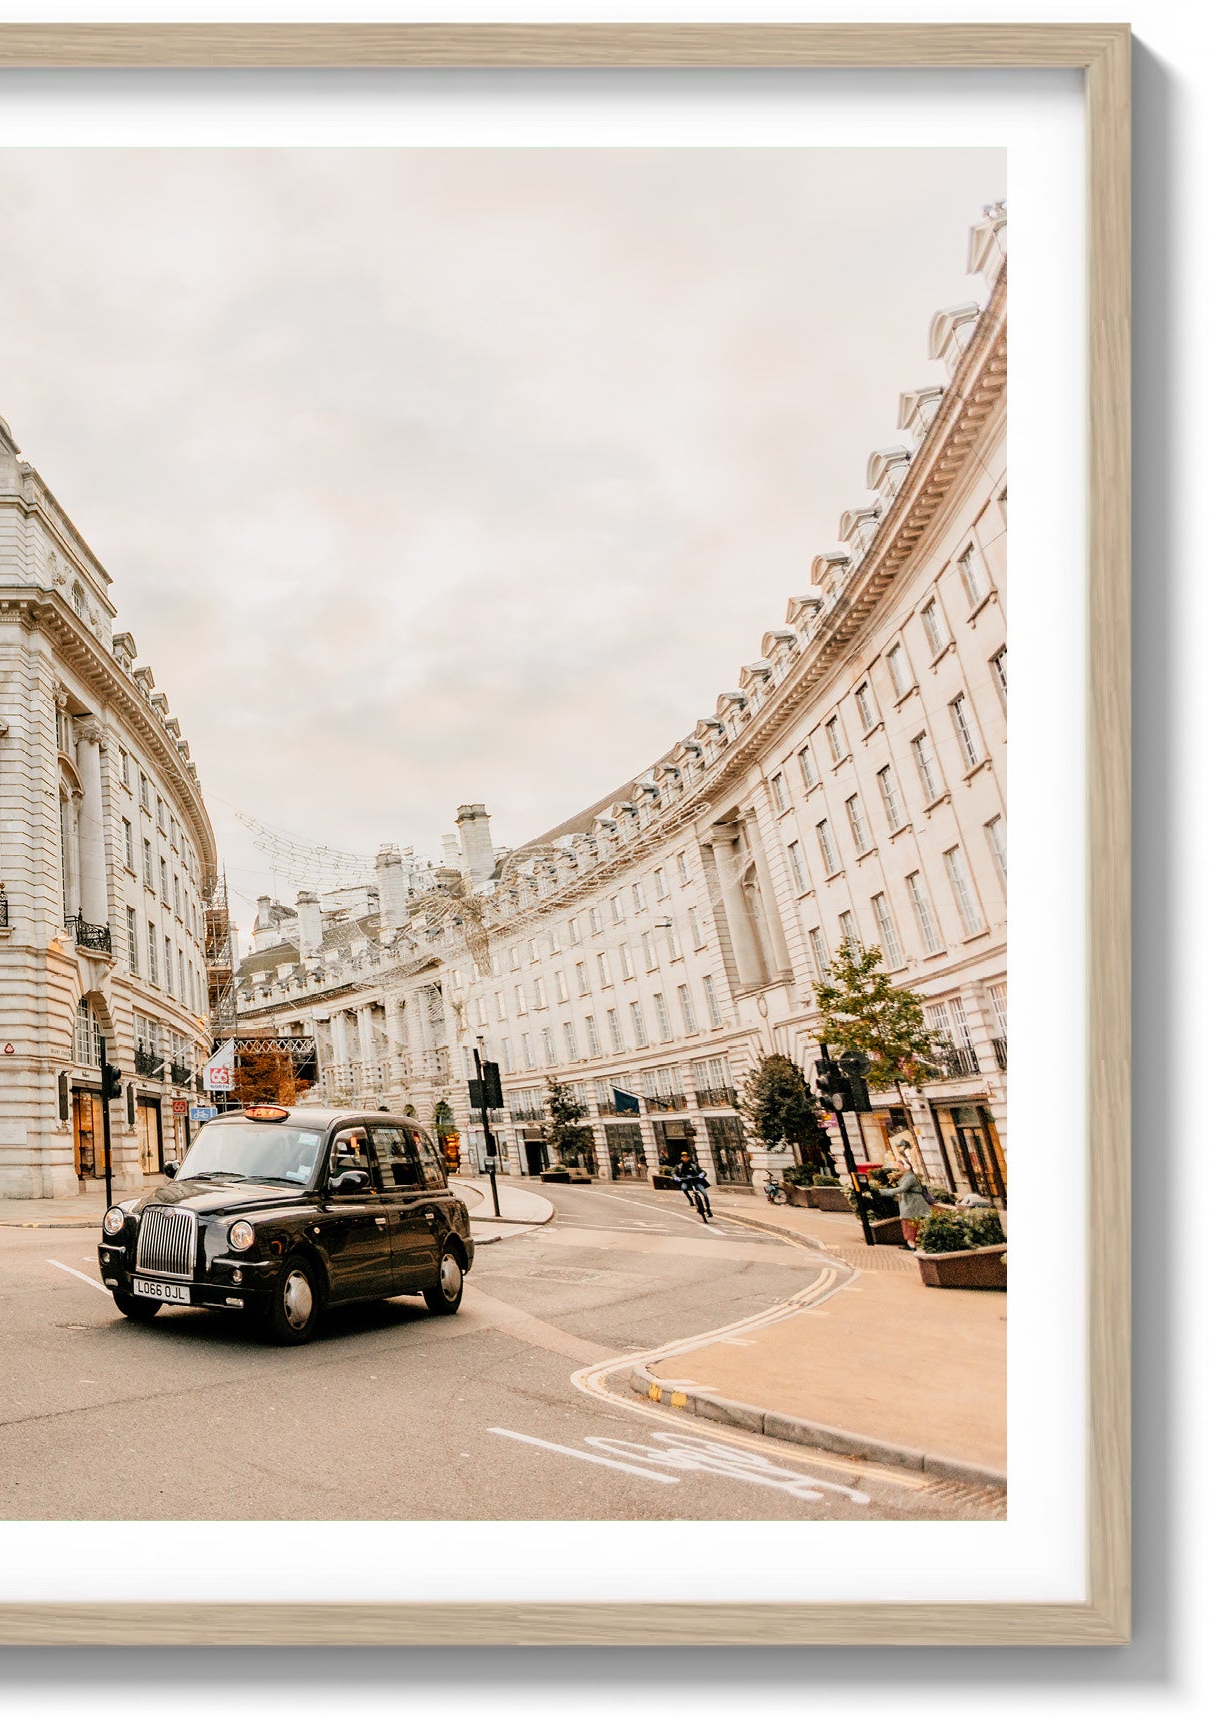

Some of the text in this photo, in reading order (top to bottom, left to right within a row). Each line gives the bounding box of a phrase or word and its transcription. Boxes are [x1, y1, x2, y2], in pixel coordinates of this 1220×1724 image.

[211, 1068, 228, 1084] 66
[174, 1101, 185, 1111] 66
[251, 1109, 276, 1117] TAXI
[137, 1280, 186, 1300] LO66 OJL
